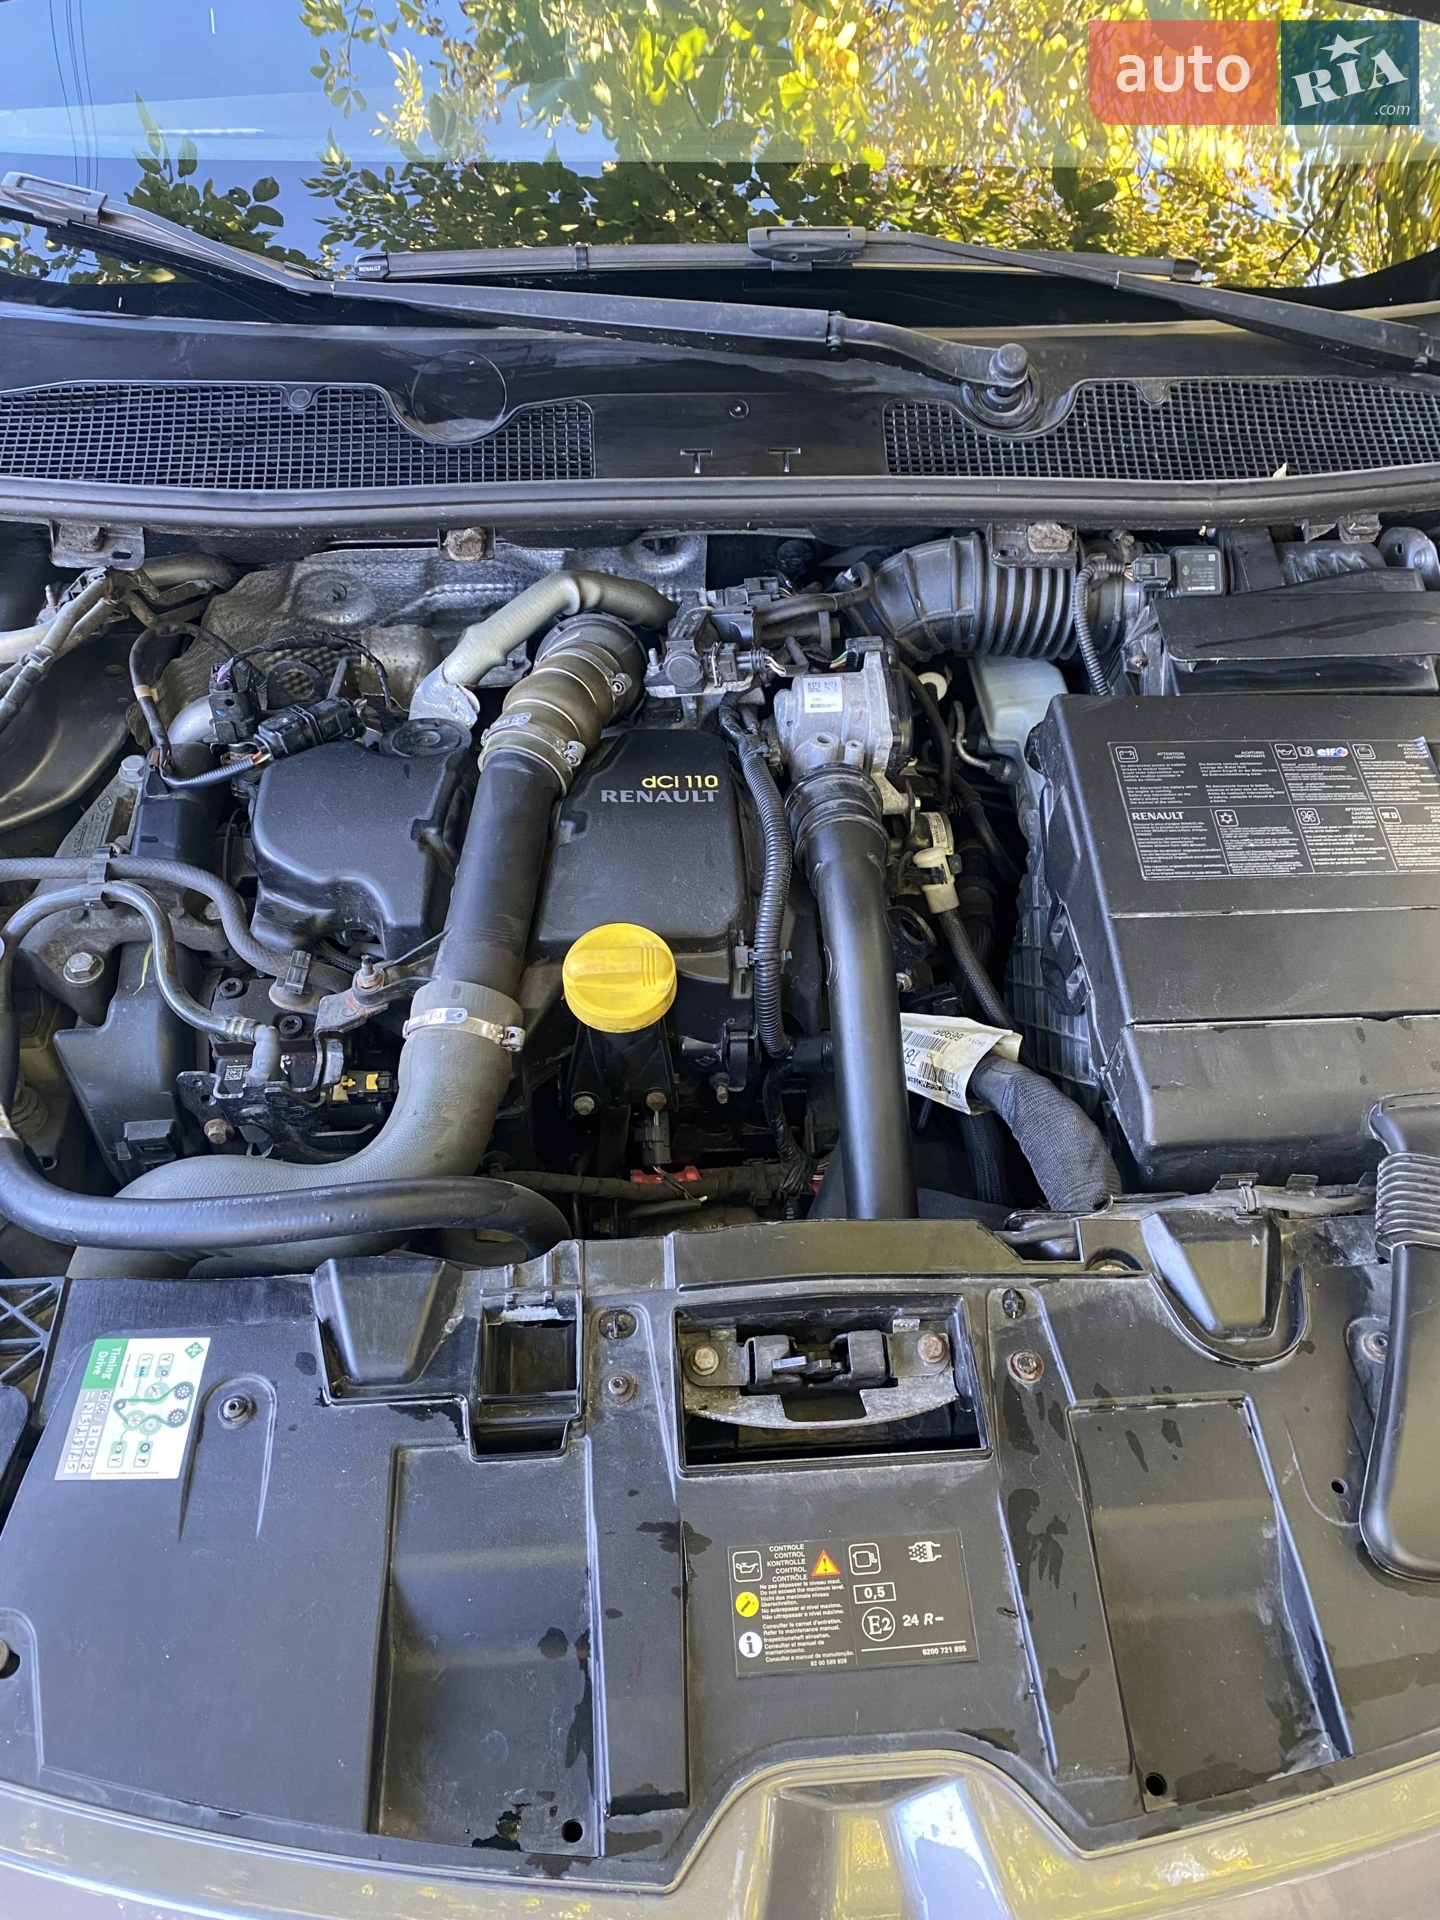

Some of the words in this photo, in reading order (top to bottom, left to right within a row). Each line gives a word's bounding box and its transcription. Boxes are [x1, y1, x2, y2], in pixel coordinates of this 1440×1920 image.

[1316, 747, 1337, 757] elf
[685, 775, 719, 788] 110
[601, 789, 719, 803] RENAULT
[1132, 812, 1184, 820] RENAULT
[92, 1351, 108, 1375] Drive
[101, 1346, 122, 1380] Timing
[769, 1544, 804, 1552] CONTROLE
[767, 1559, 806, 1567] KONTROLLE
[775, 1566, 807, 1574] CONTROL
[772, 1574, 808, 1582] CONTRÔLE
[864, 1586, 885, 1600] 0,5
[866, 1615, 892, 1635] E2
[902, 1614, 919, 1626] 24
[922, 1648, 939, 1656] 8200
